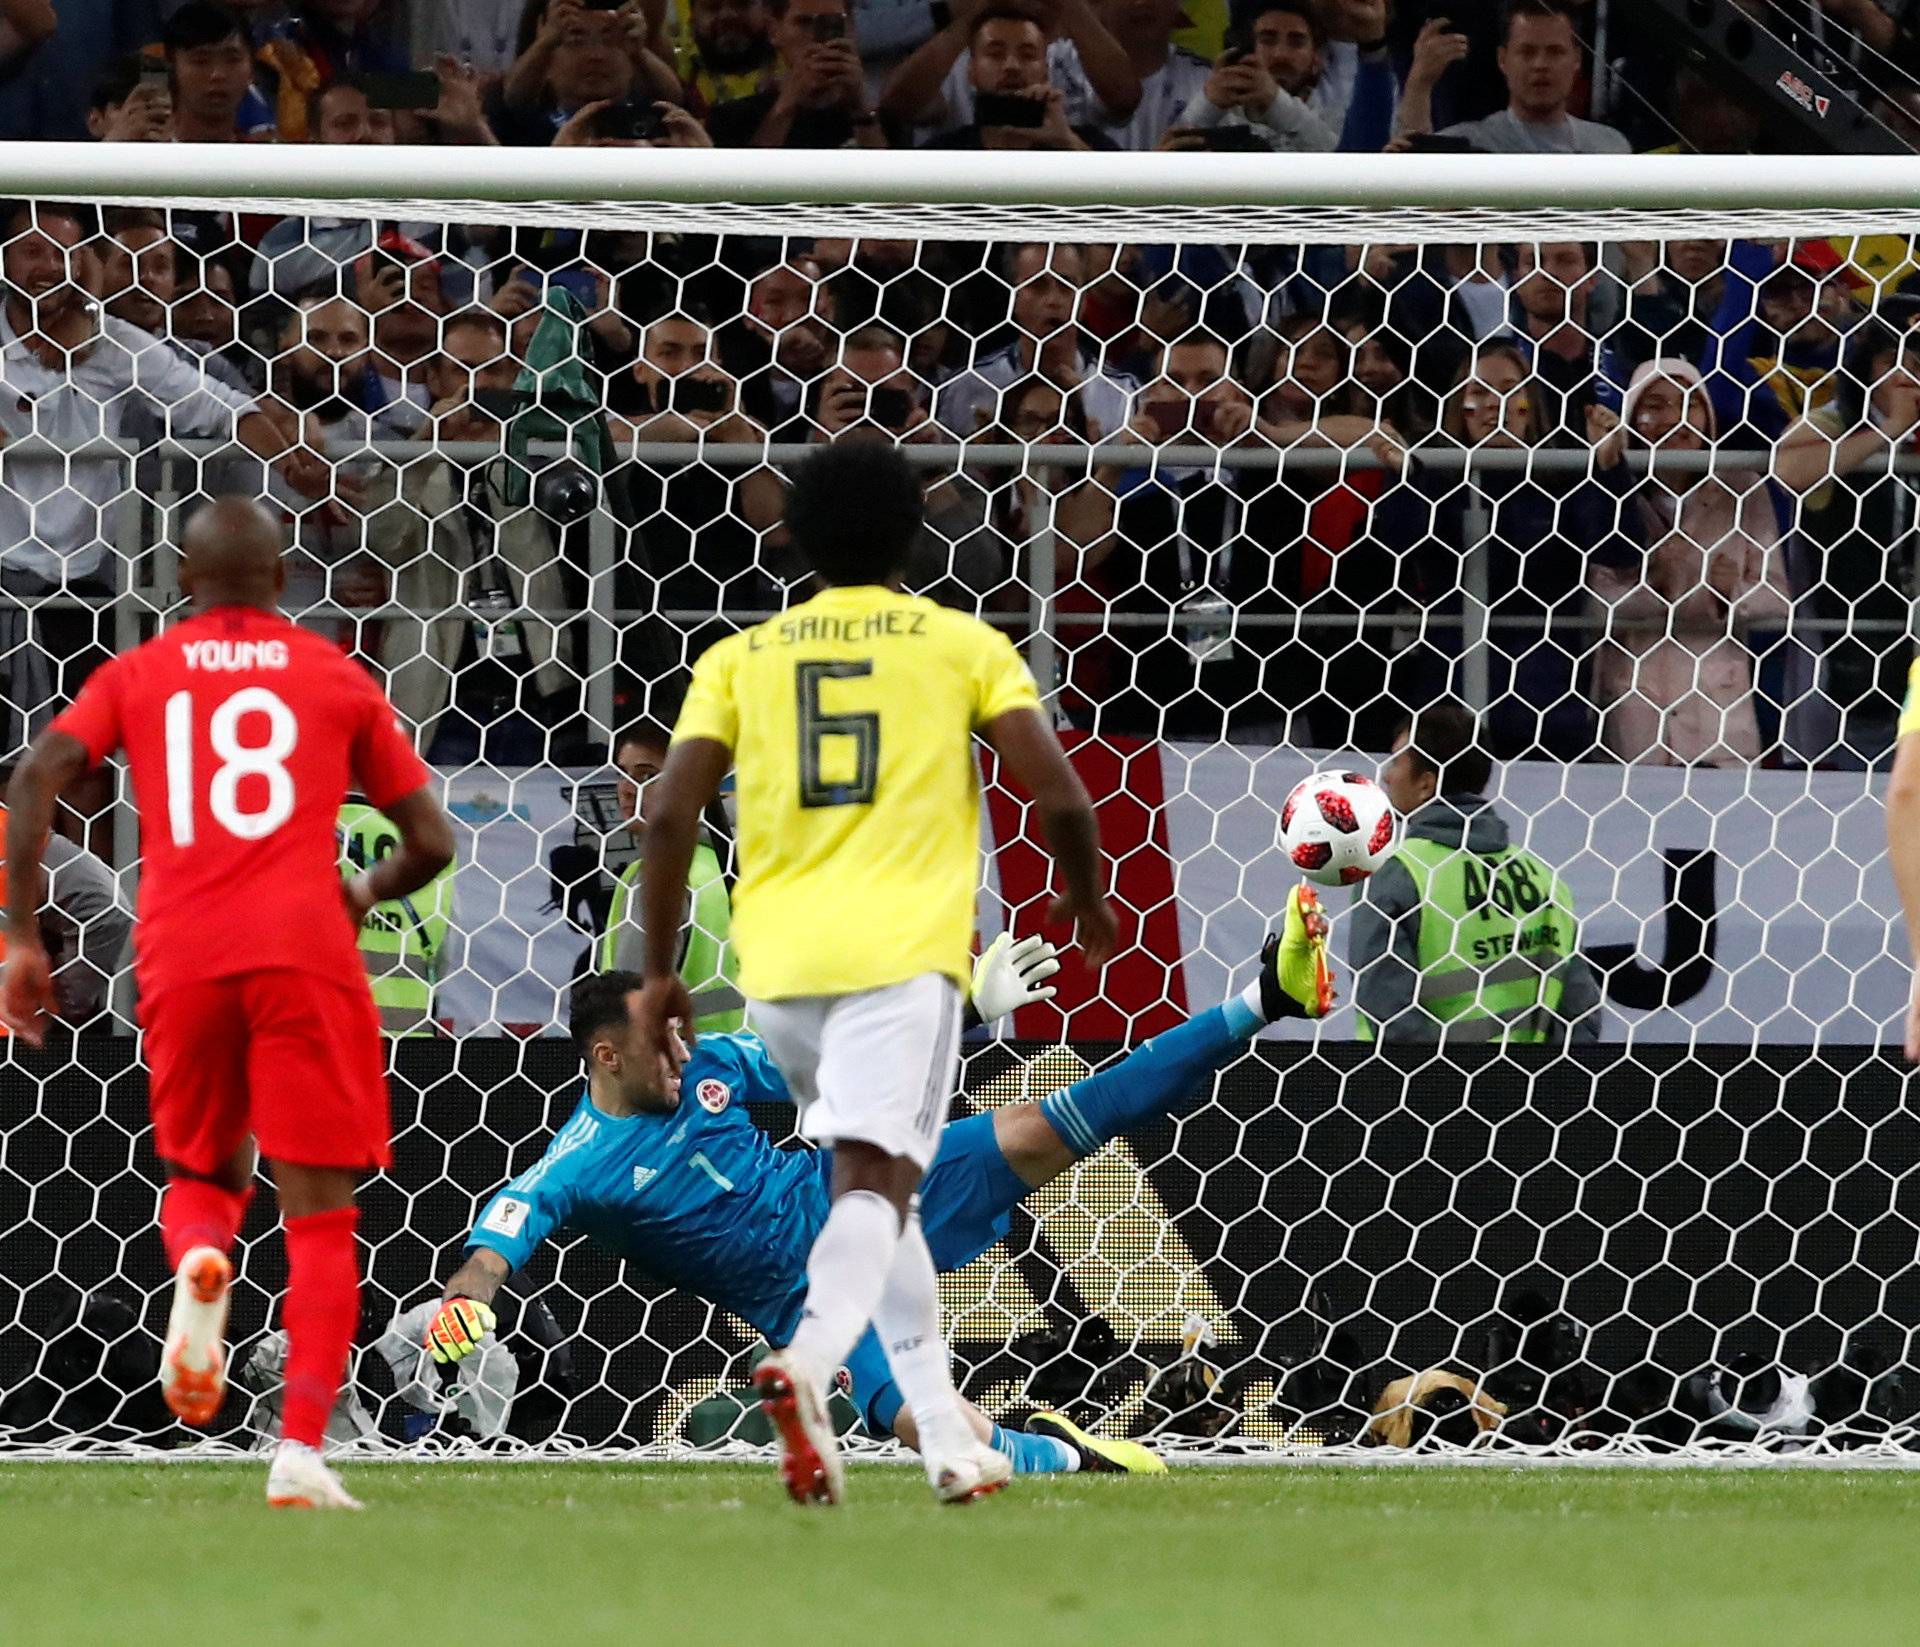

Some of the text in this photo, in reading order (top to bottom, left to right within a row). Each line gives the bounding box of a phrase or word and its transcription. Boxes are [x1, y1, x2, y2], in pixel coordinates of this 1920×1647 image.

[181, 640, 289, 671] YOUNG
[165, 686, 298, 847] 18
[797, 659, 880, 808] 6
[1584, 848, 1716, 1010] J
[688, 1151, 734, 1192] 1
